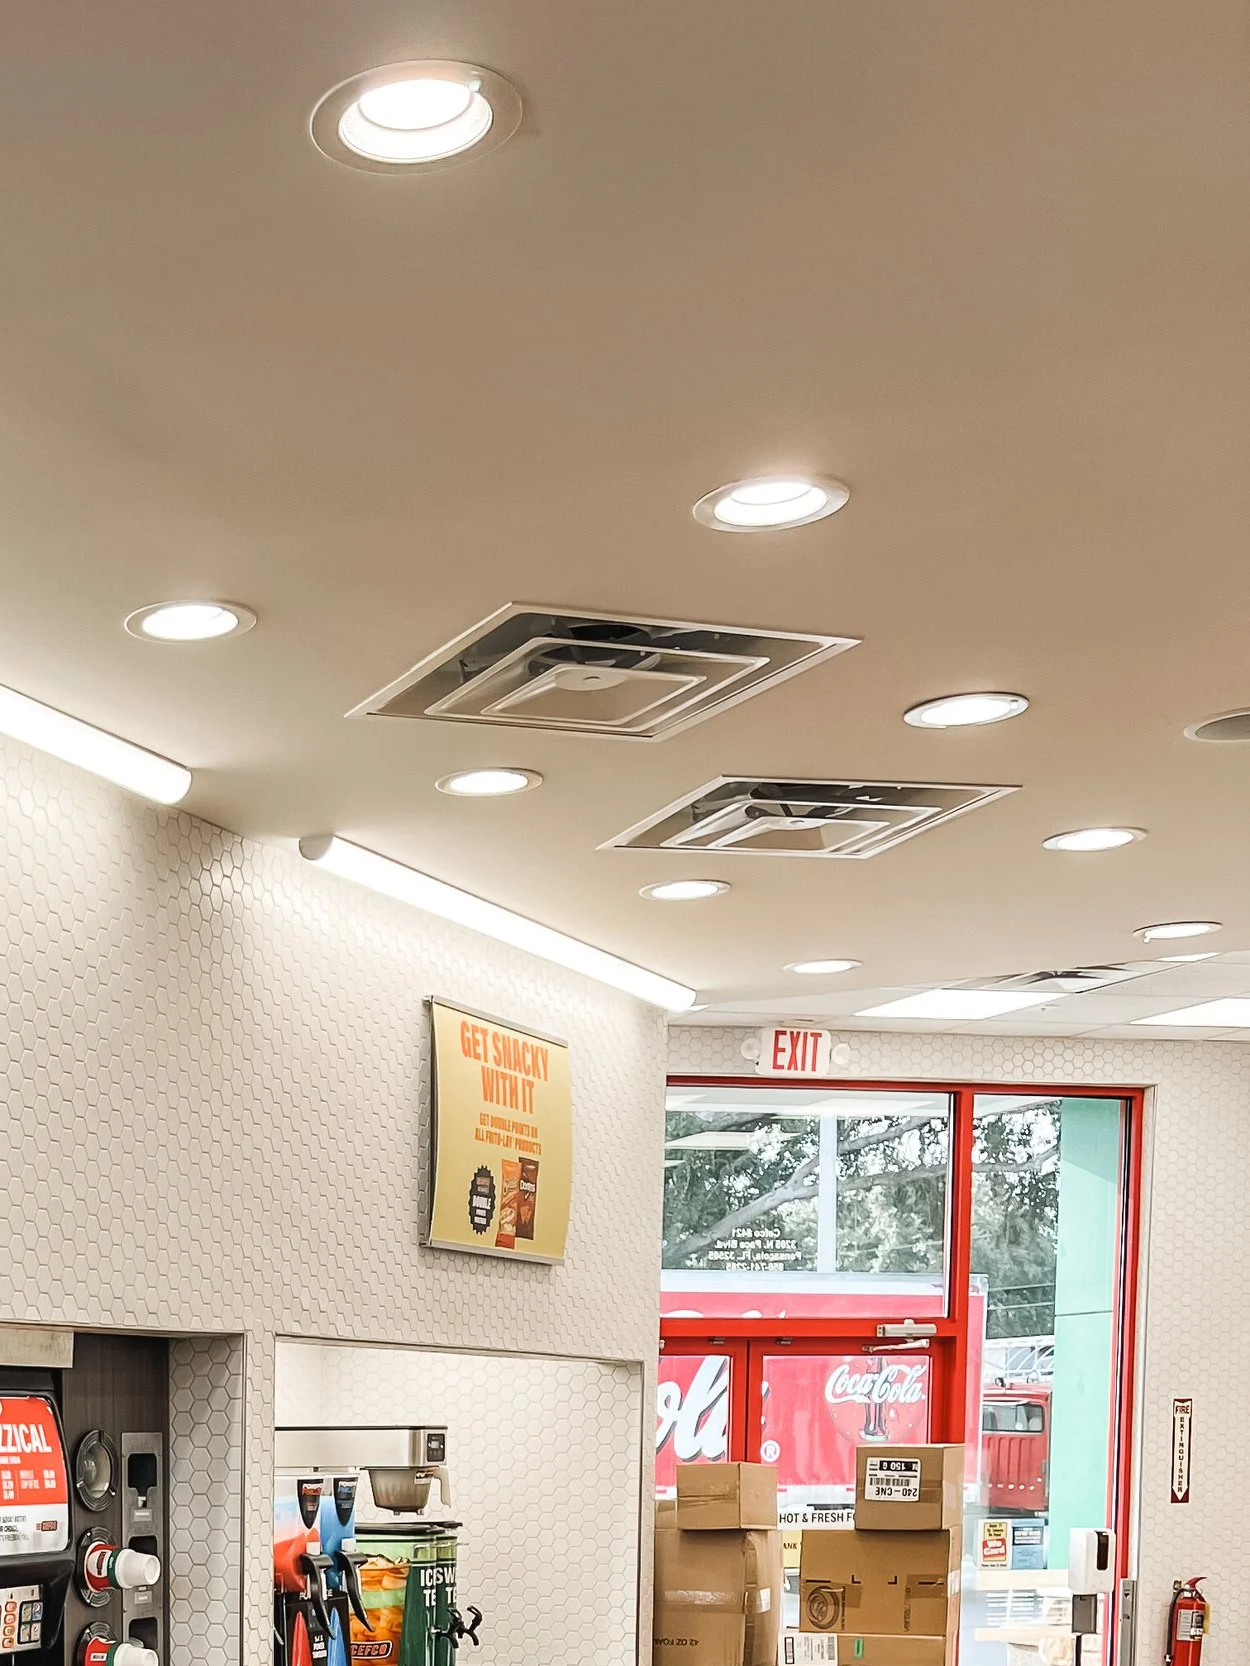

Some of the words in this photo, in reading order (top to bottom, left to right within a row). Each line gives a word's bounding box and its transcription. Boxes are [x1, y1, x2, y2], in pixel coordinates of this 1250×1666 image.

[461, 1020, 488, 1063] GET
[493, 1037, 549, 1081] SNACKY
[772, 1030, 822, 1072] EXIT
[481, 1066, 518, 1110] WITH
[520, 1079, 534, 1114] IT
[480, 1112, 489, 1126] GET
[475, 1128, 484, 1142] ALL
[519, 1179, 536, 1193] Doritos
[1175, 1405, 1189, 1414] FIRE
[890, 1462, 906, 1471] 150
[779, 1513, 800, 1524] HOT
[802, 1513, 808, 1523] &
[811, 1512, 844, 1524] FRESH
[783, 1542, 797, 1550] ANK
[676, 1638, 688, 1646] OZ
[351, 1644, 388, 1656] CEFCO
